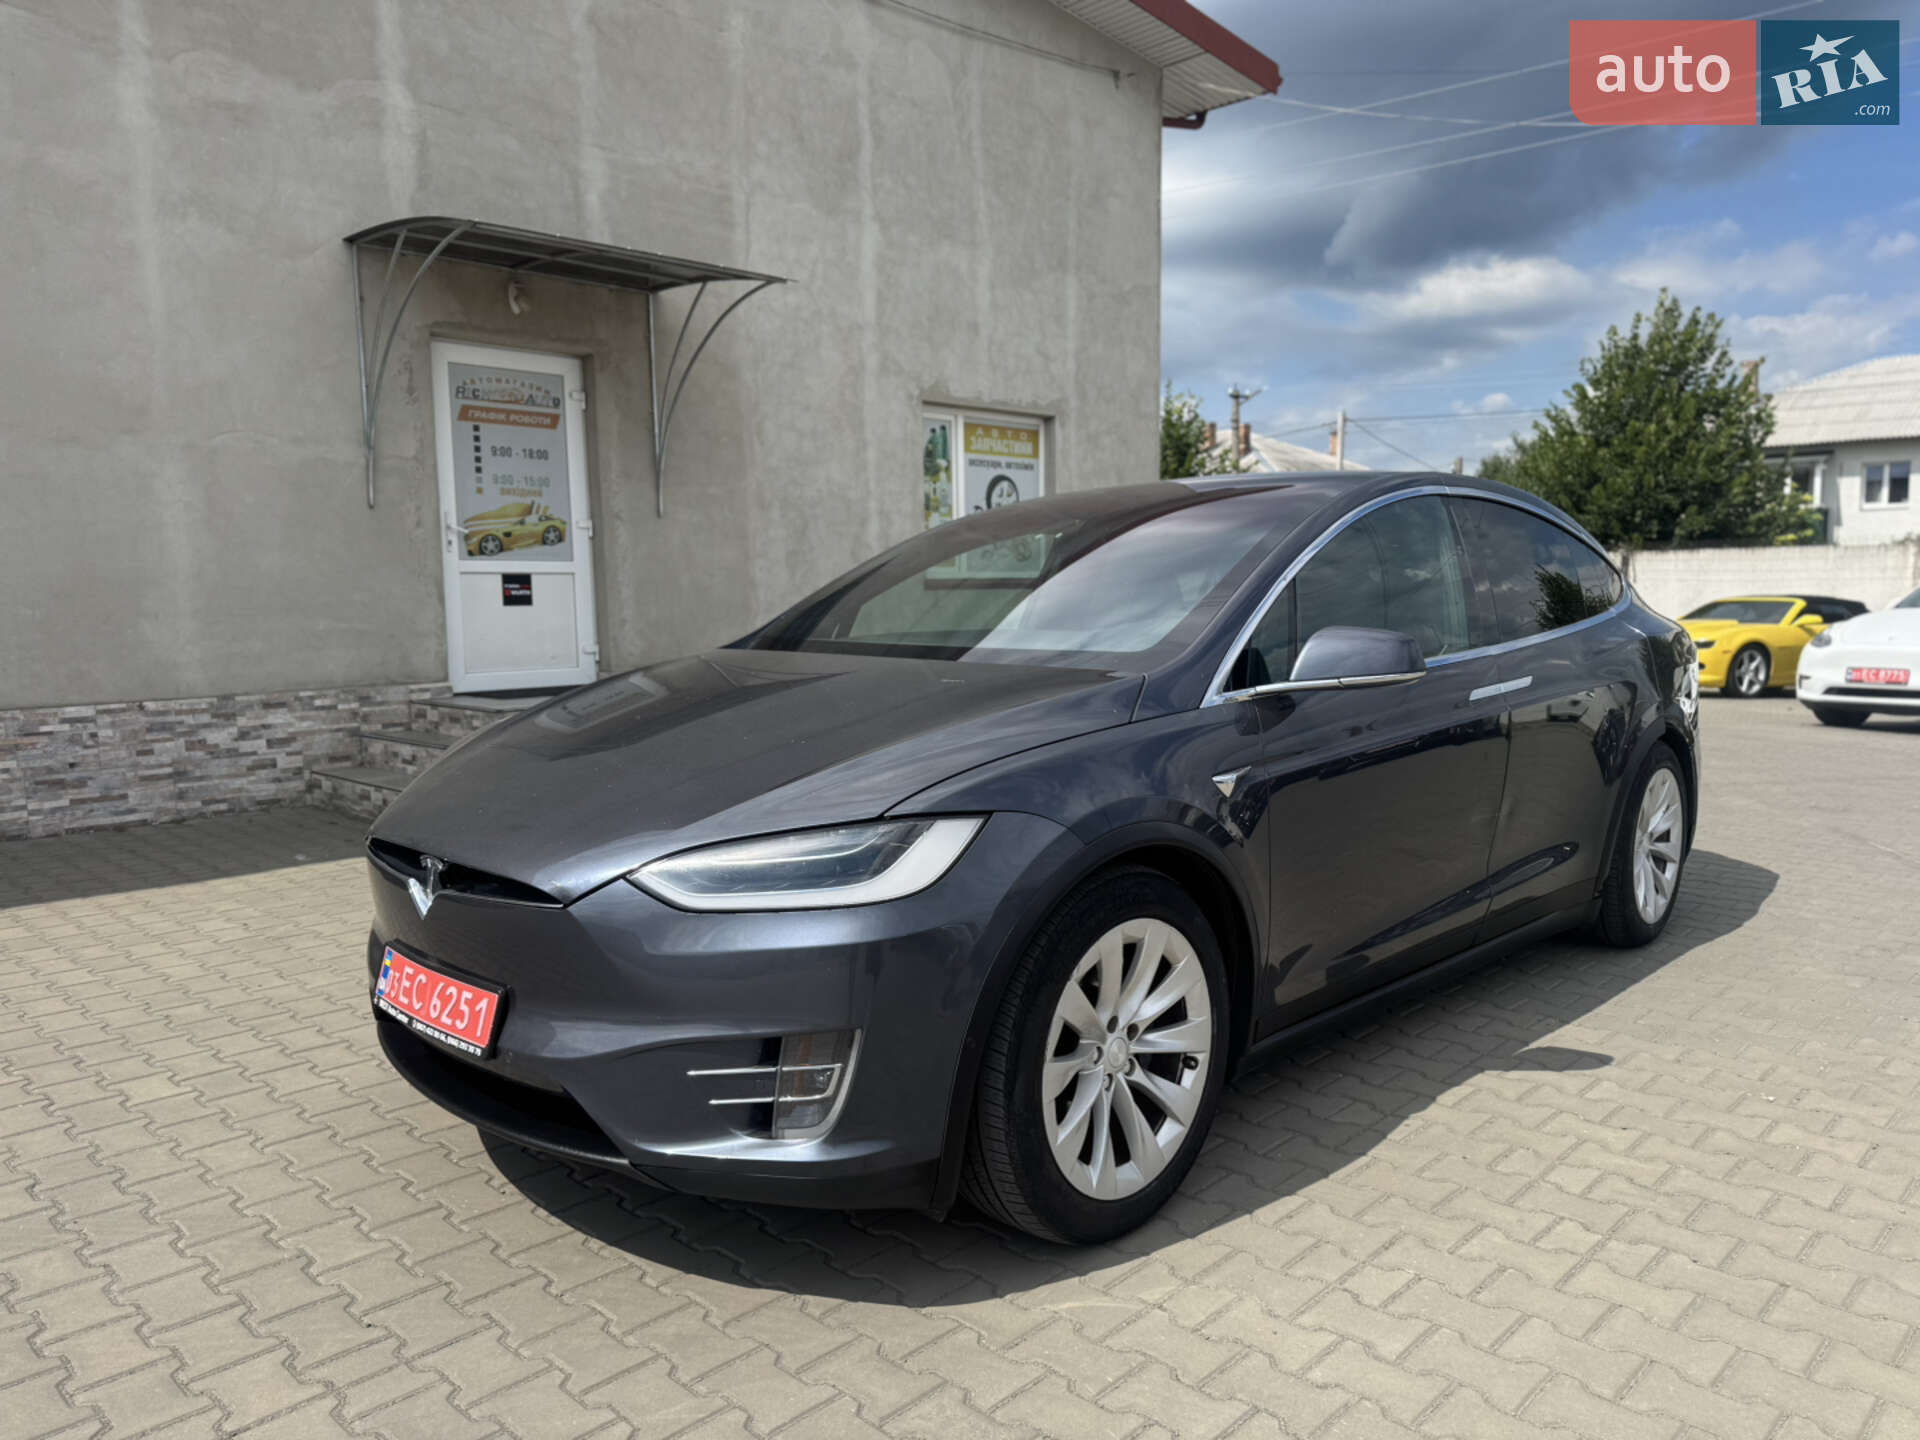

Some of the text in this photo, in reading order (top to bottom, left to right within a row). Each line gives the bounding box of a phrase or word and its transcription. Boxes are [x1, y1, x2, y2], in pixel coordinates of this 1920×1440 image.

[467, 408, 551, 426] ГРАФІК РОБОТИ
[490, 445, 513, 458] 9:00
[522, 448, 549, 461] 18:00
[970, 435, 1033, 456] ЗАПЧАСТИНИ
[429, 982, 490, 1038] 6251
